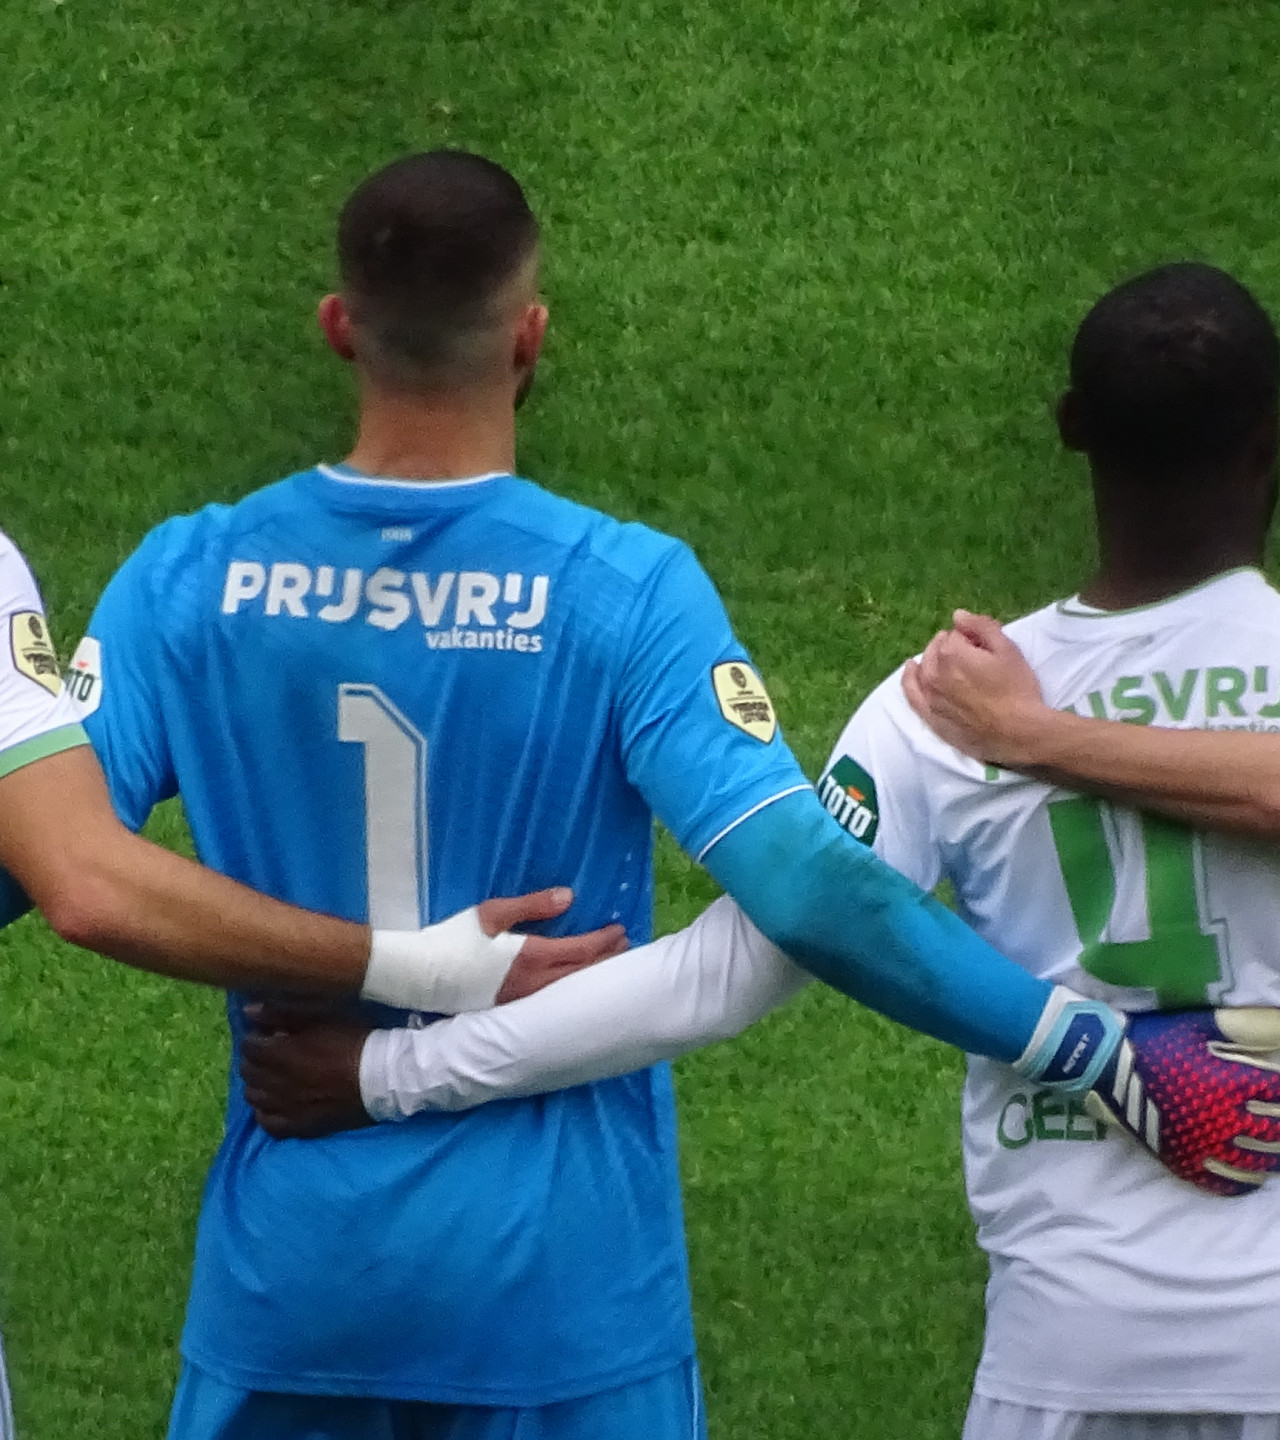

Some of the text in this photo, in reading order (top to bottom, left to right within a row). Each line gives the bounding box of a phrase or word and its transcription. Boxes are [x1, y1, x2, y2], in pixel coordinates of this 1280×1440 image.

[424, 624, 543, 654] vakanties
[338, 684, 428, 930] 1
[821, 775, 873, 839] TOTO
